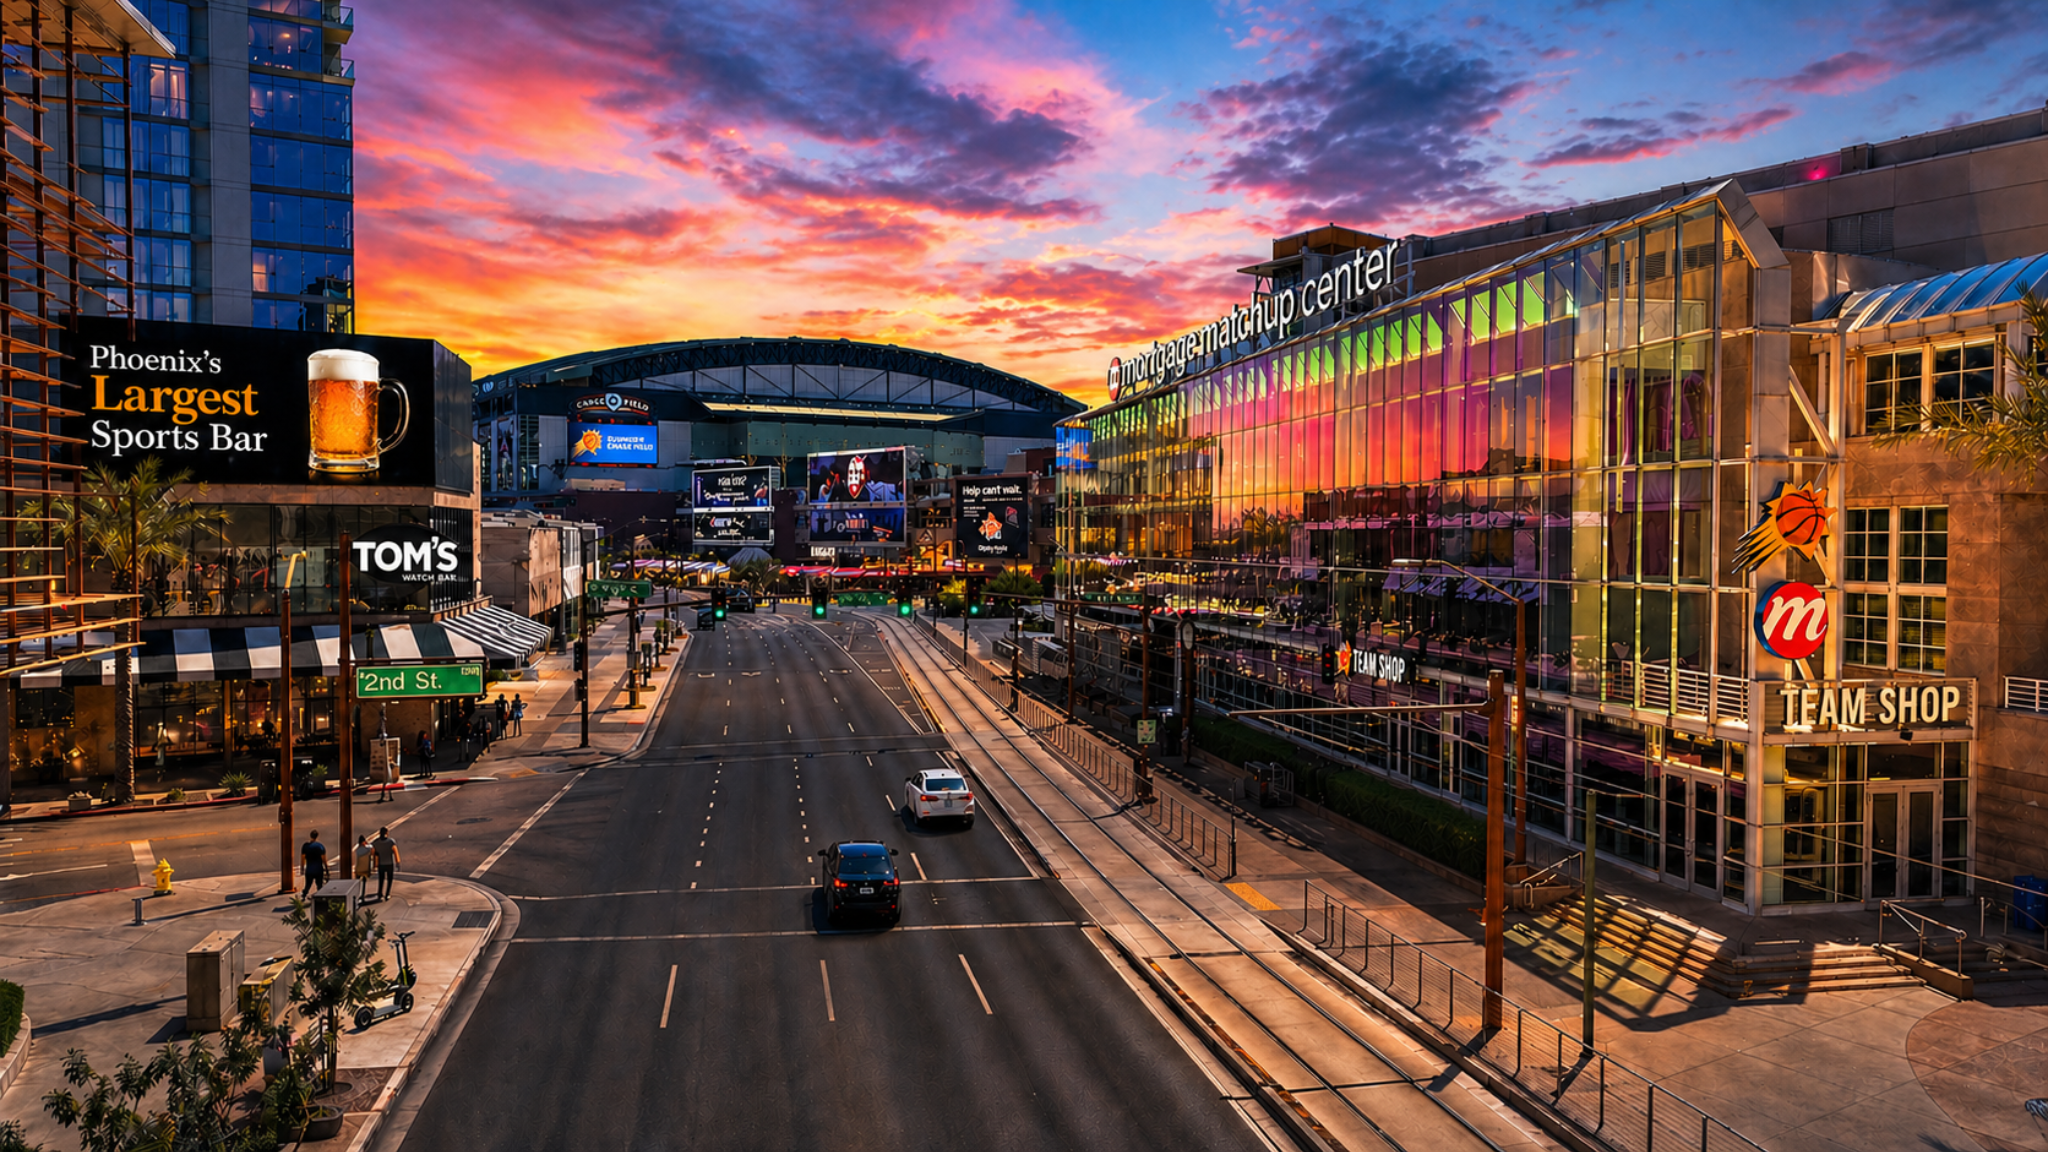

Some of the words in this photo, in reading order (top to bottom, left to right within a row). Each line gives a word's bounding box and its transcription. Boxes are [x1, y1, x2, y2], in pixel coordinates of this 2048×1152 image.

[1119, 332, 1196, 385] mortgage
[1199, 288, 1295, 356] matchup
[1301, 239, 1398, 318] center
[91, 374, 259, 424] Largest
[91, 420, 199, 457] Sports
[209, 423, 268, 453] Bar
[402, 574, 435, 582] WATCH
[437, 574, 457, 582] BAR
[1762, 596, 1827, 641] m
[365, 671, 405, 692] 2nd
[415, 671, 442, 690] St.
[1353, 649, 1377, 678] TEAM
[1379, 654, 1406, 683] SHOP
[1780, 687, 1865, 725] TEAM
[1879, 685, 1961, 725] SHOP
